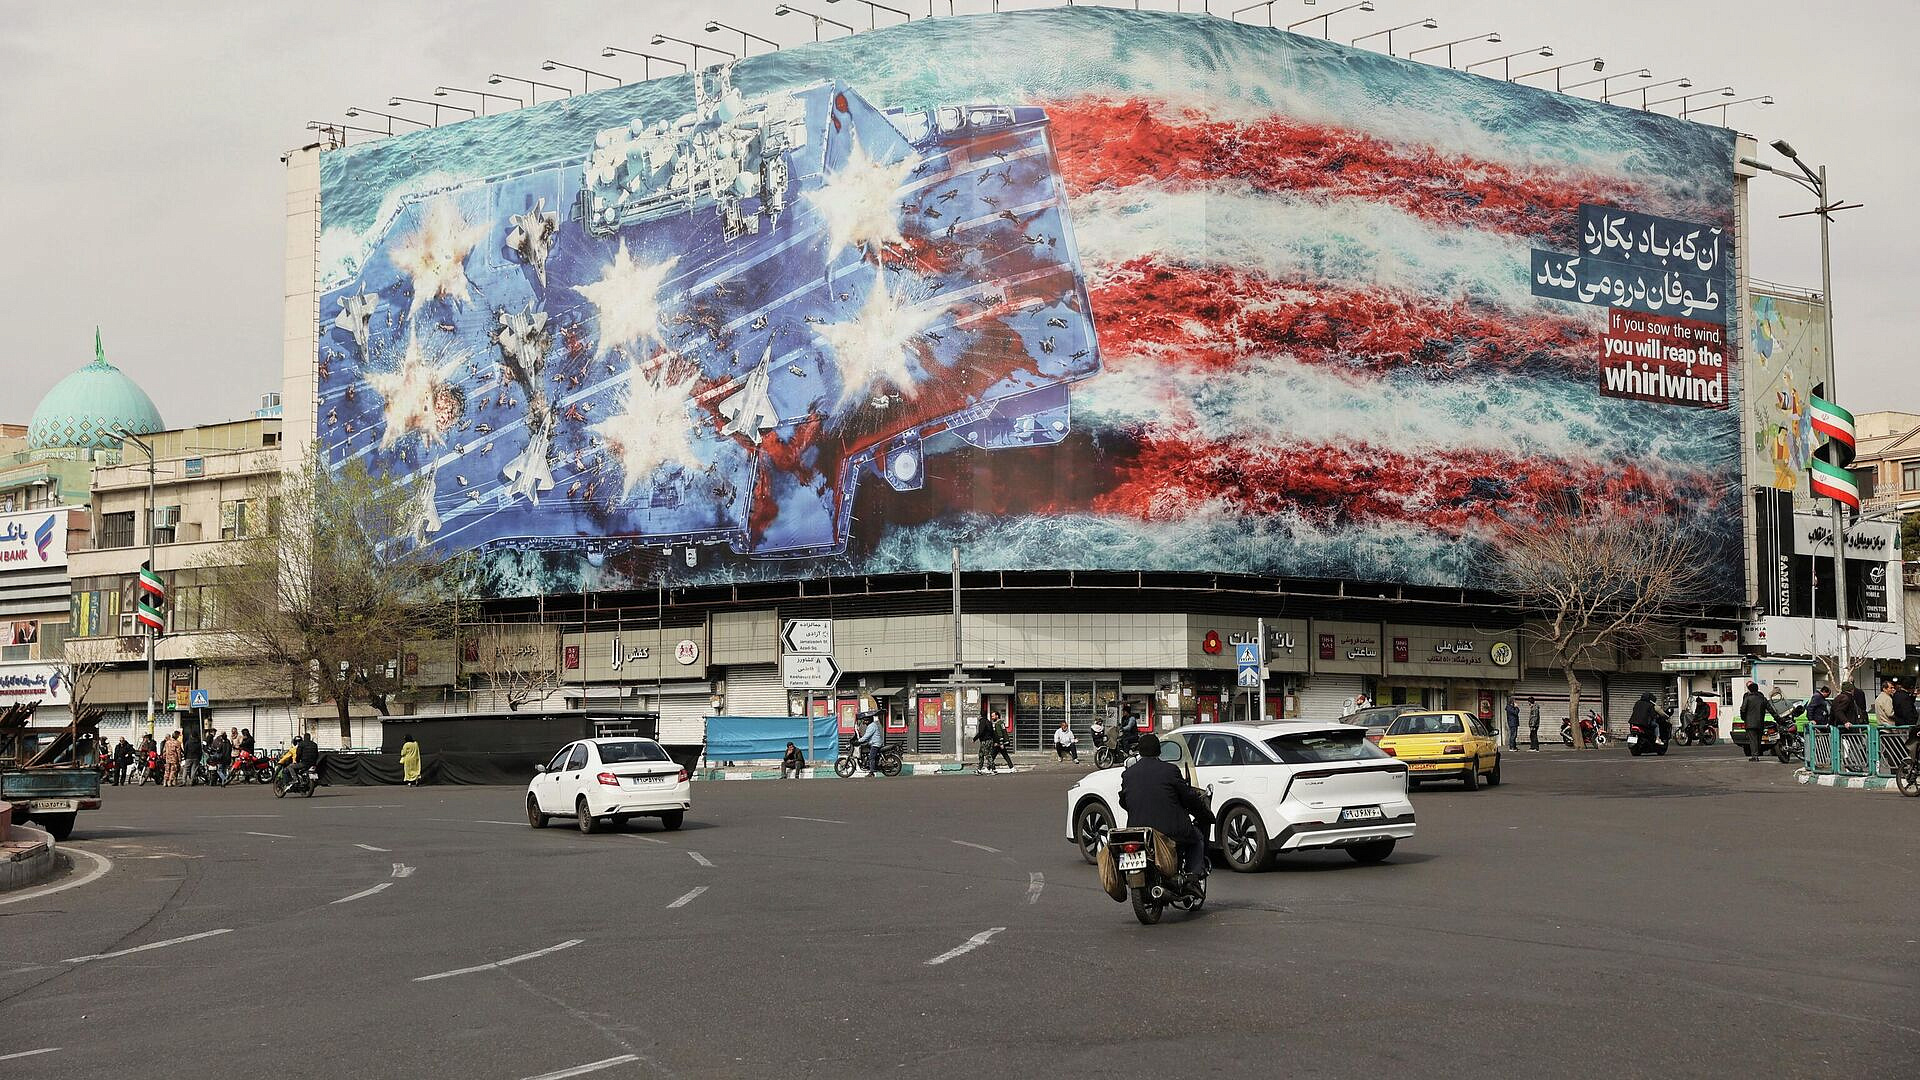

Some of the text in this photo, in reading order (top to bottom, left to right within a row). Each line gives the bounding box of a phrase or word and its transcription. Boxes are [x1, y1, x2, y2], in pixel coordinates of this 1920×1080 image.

[1584, 214, 1722, 271] آن که باد بکارد
[1646, 271, 1719, 316] طوفان
[1612, 314, 1722, 345] If you sow the wind,
[1604, 337, 1722, 368] you will reap the
[1604, 361, 1723, 404] whirlwind
[4, 549, 28, 562] BANK
[1780, 555, 1790, 616] SAMSUNG
[626, 647, 650, 662] کفش
[1436, 639, 1474, 653] کفش ملی
